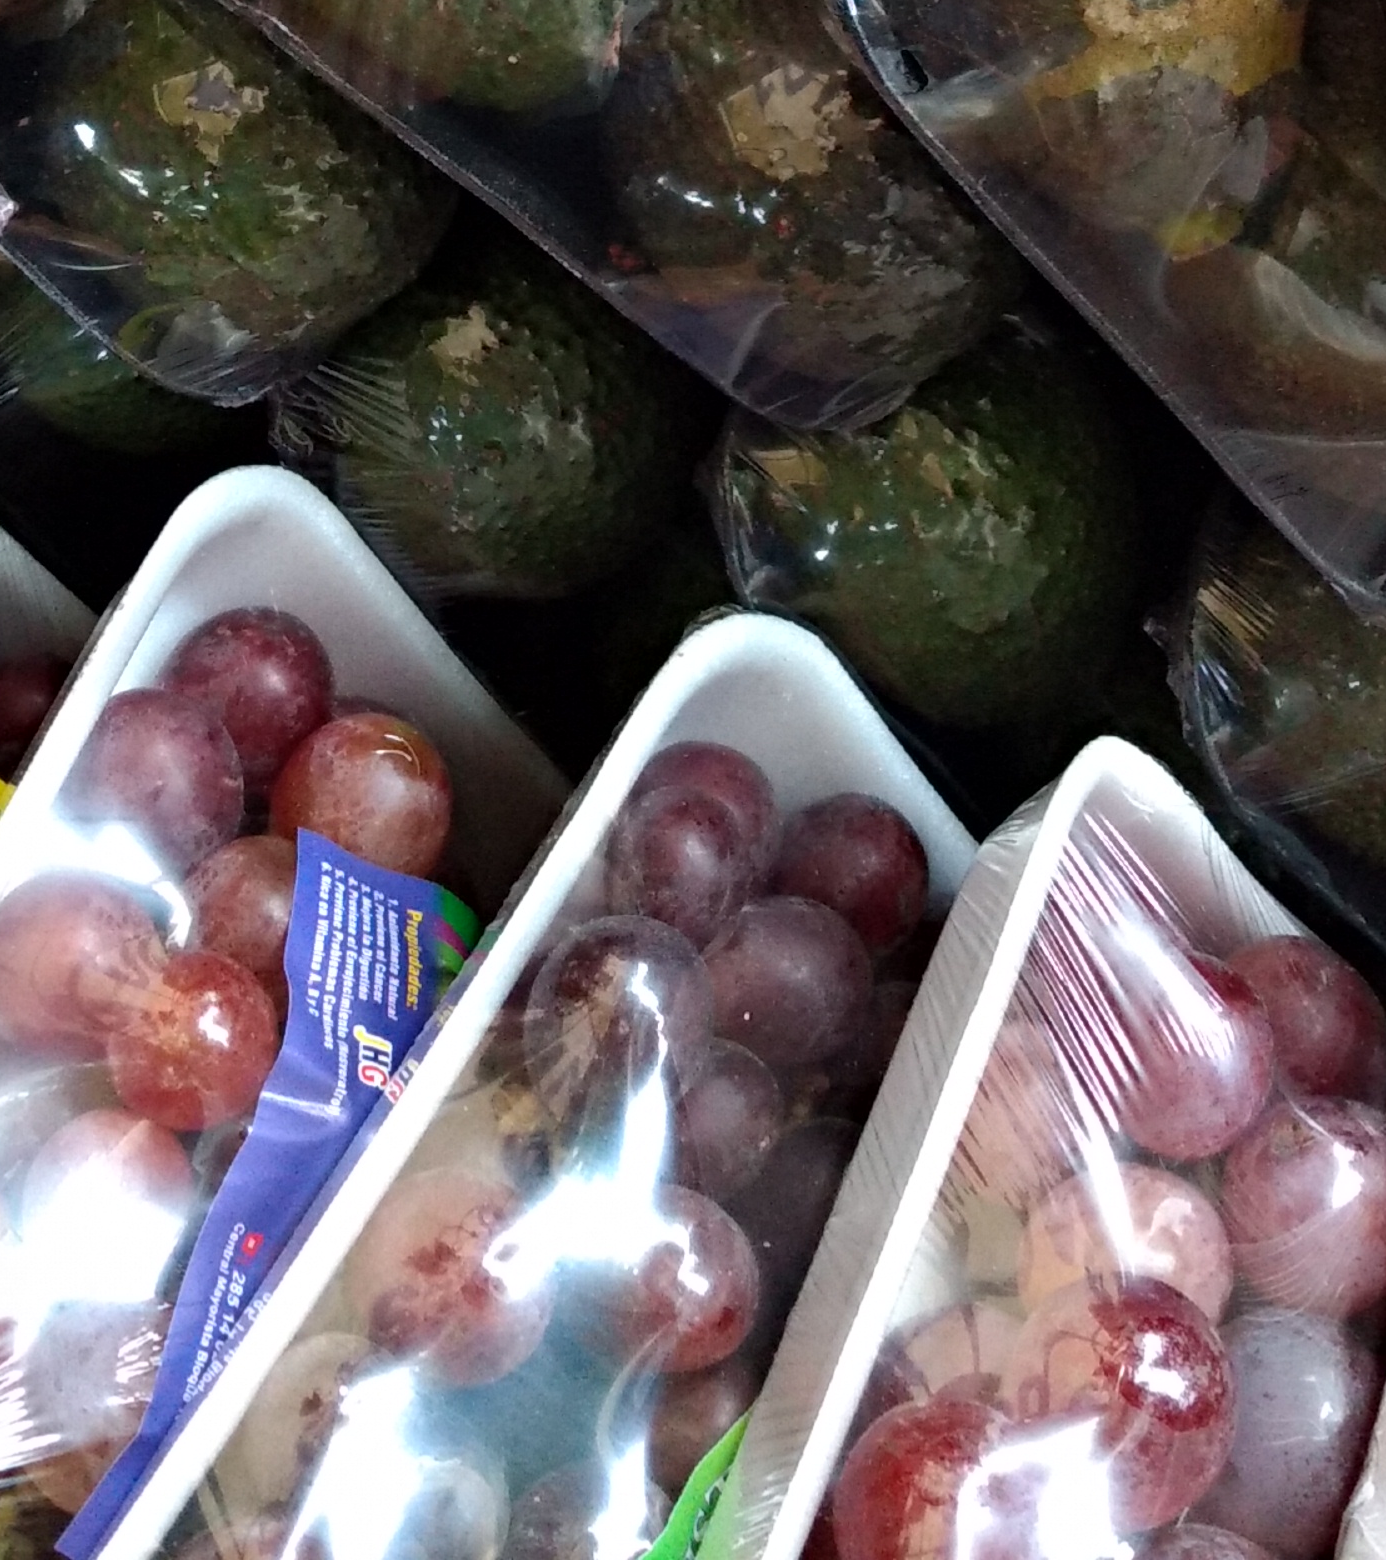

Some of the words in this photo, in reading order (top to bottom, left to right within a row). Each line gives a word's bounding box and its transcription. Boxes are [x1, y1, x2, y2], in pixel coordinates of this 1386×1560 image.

[333, 881, 345, 929] Previene
[348, 888, 359, 936] Previene
[360, 895, 373, 932] Mejora
[311, 919, 329, 971] Vitamina
[324, 930, 344, 992] Problemas
[403, 908, 424, 1011] Propiedades:
[337, 950, 358, 1039] Envejecimiento
[358, 947, 373, 1001] Digestión
[373, 962, 387, 1004] Cáncer
[387, 976, 400, 1021] Natural
[353, 1024, 393, 1091] JHG
[220, 1222, 246, 1275] Central
[200, 1275, 228, 1347] Mayorista
[227, 1269, 246, 1309] 285
